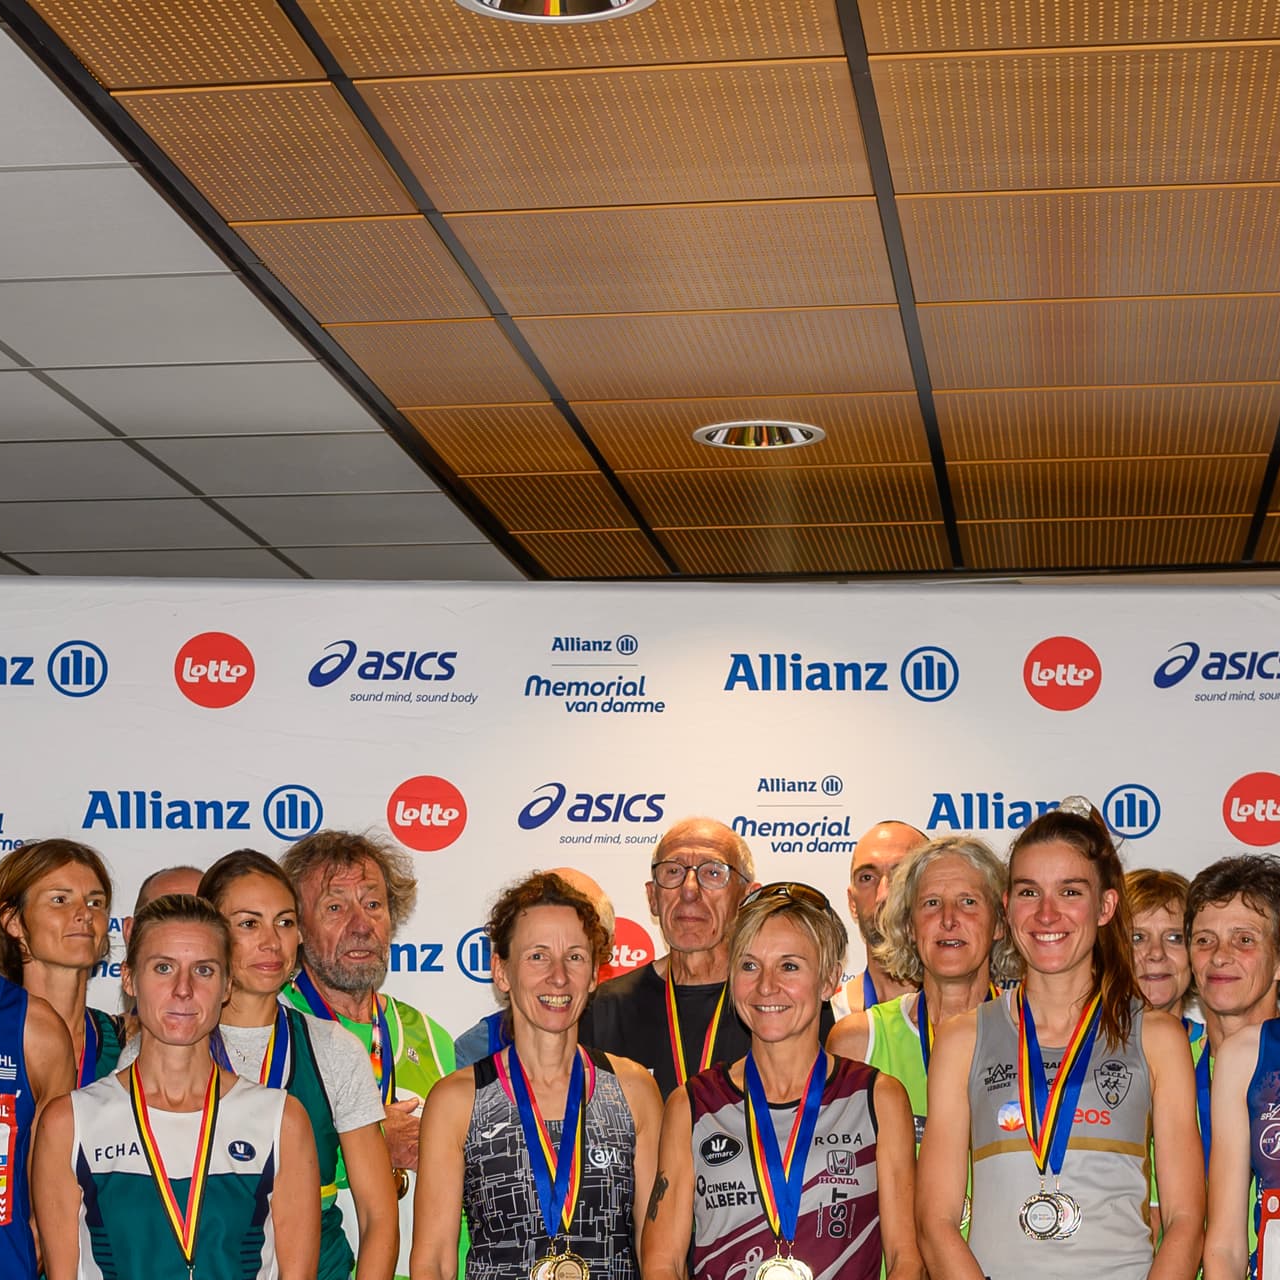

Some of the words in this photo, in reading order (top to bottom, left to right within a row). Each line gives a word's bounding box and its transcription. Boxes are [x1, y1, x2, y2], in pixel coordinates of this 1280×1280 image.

[551, 637, 612, 651] Allianz
[181, 657, 247, 683] Lotto
[723, 653, 888, 691] Allianz
[1031, 661, 1095, 687] Lotto
[524, 675, 646, 697] Memorial
[349, 691, 383, 702] sound
[384, 691, 413, 704] mind,
[415, 692, 449, 703] sound
[450, 692, 478, 705] body
[1194, 691, 1227, 702] sound
[1229, 690, 1256, 702] mind,
[565, 700, 598, 712] van
[601, 697, 665, 713] damme
[757, 777, 818, 793] Allianz
[81, 790, 251, 830] Allianz
[394, 800, 460, 827] Lotto
[731, 815, 851, 837] Memorial
[559, 834, 592, 844] sound
[594, 833, 622, 844] mind,
[624, 833, 657, 844] sound
[770, 841, 804, 853] van
[806, 837, 858, 853] damm
[815, 1133, 863, 1146] ROBA
[95, 1142, 140, 1162] FCHA
[707, 1180, 746, 1194] CINEMA
[819, 1177, 860, 1186] HONDA
[705, 1191, 758, 1211] ALBERT
